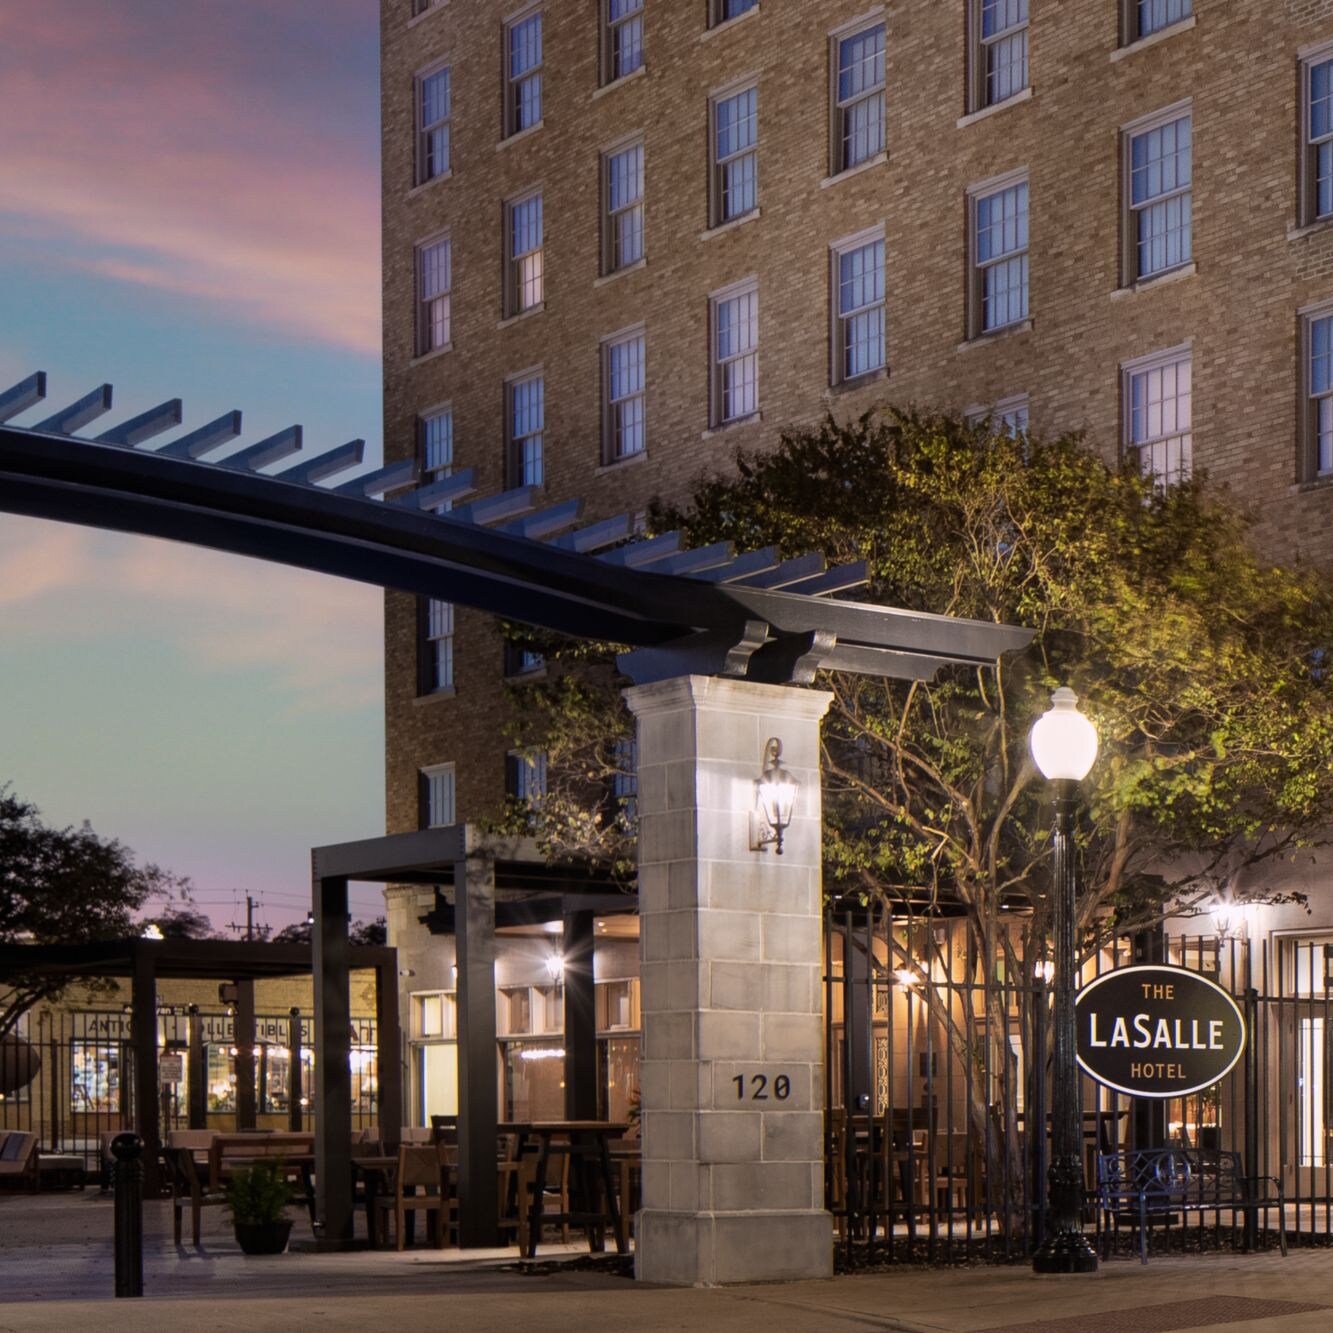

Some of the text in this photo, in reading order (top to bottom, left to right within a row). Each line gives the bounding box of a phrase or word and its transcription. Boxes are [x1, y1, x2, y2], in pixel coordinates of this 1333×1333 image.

[1142, 983, 1174, 1000] THE
[1130, 1063, 1187, 1079] HOTEL
[732, 1073, 791, 1100] 120
